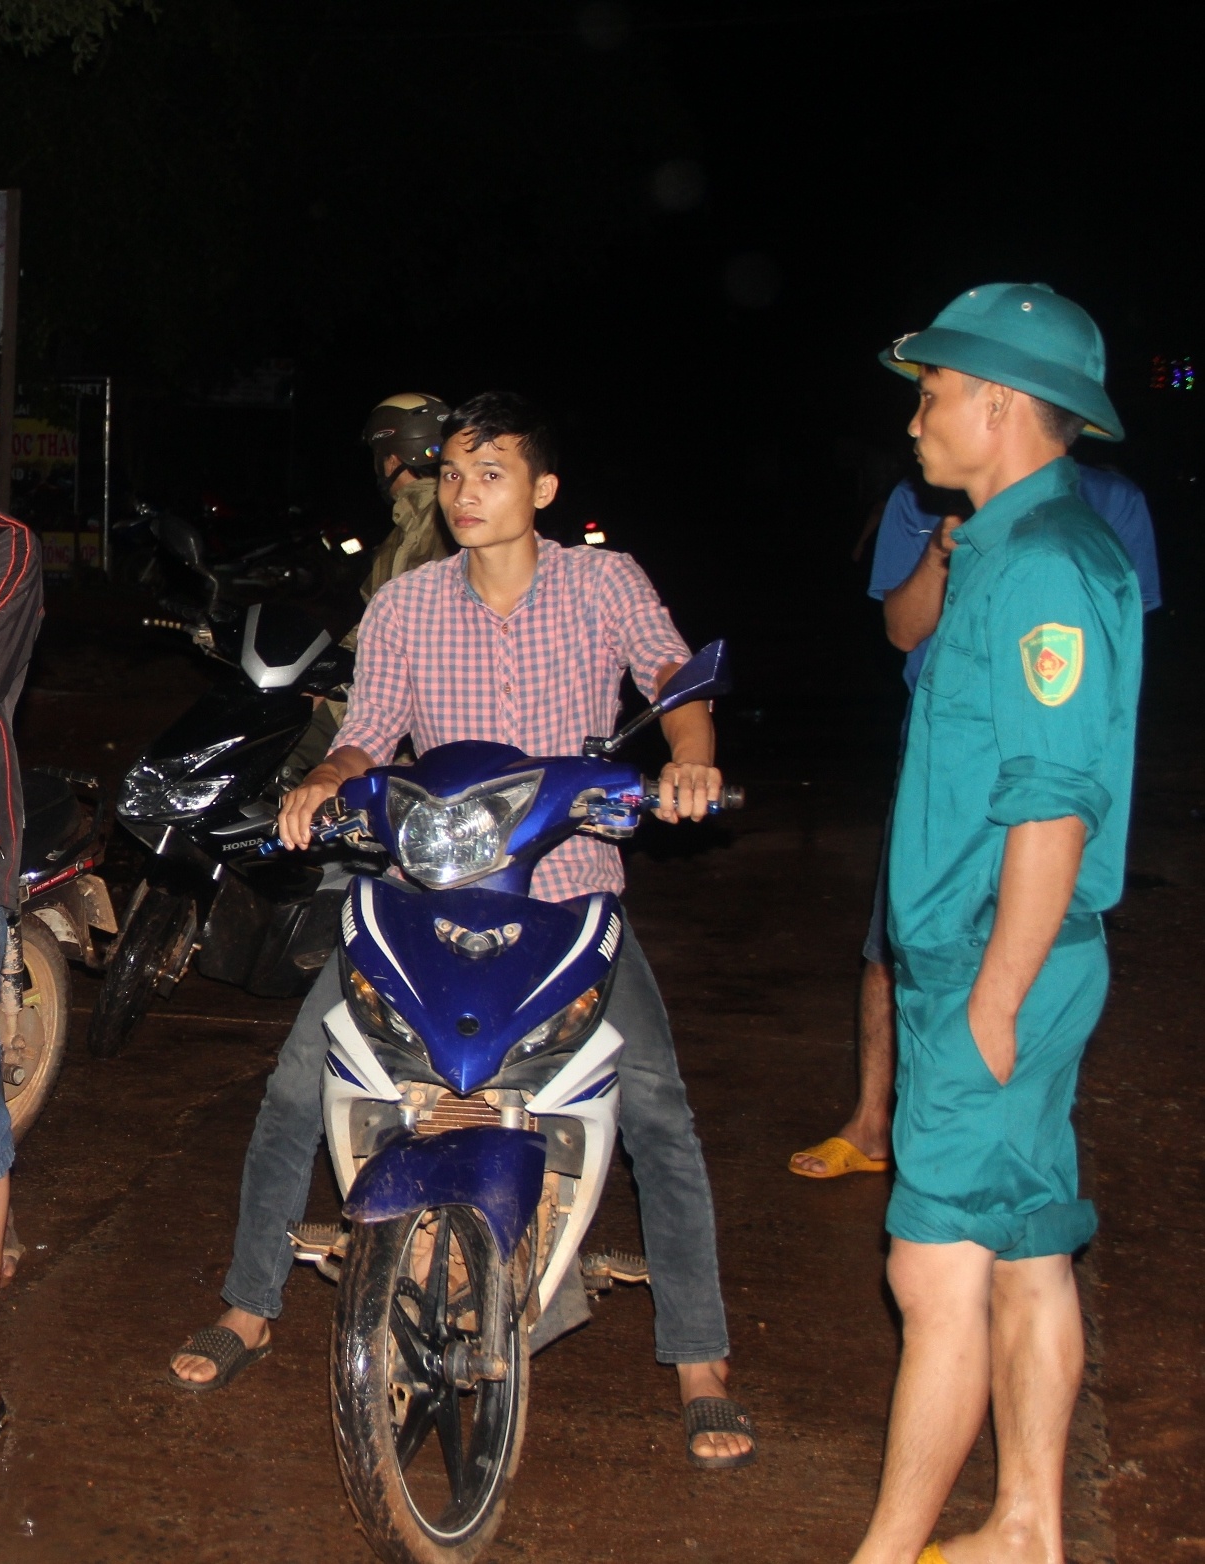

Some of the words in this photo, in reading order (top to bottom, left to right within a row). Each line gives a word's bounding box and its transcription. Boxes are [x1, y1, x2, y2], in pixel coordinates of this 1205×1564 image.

[222, 837, 265, 852] HONDA
[341, 895, 359, 947] YAMAHA
[597, 912, 622, 962] YAMAHA
